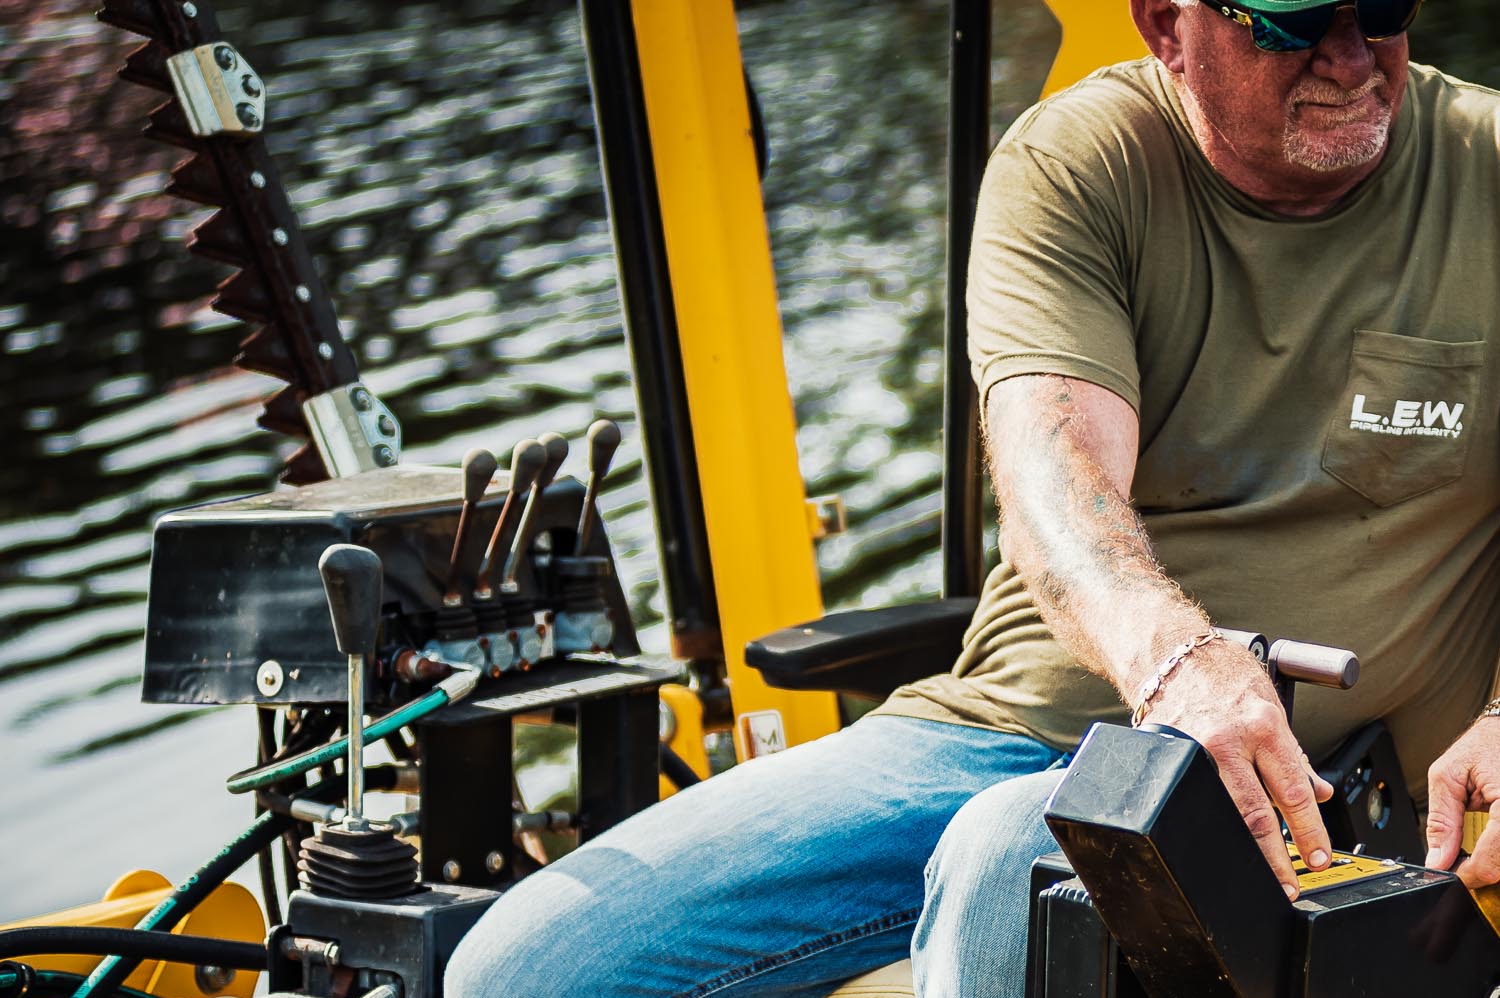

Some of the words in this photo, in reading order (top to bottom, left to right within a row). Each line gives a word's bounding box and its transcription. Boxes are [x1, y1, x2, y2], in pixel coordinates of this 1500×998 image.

[1351, 394, 1464, 430] L.E.W.
[1350, 421, 1403, 435] PIPELINE
[1403, 426, 1461, 439] INTEGRITY
